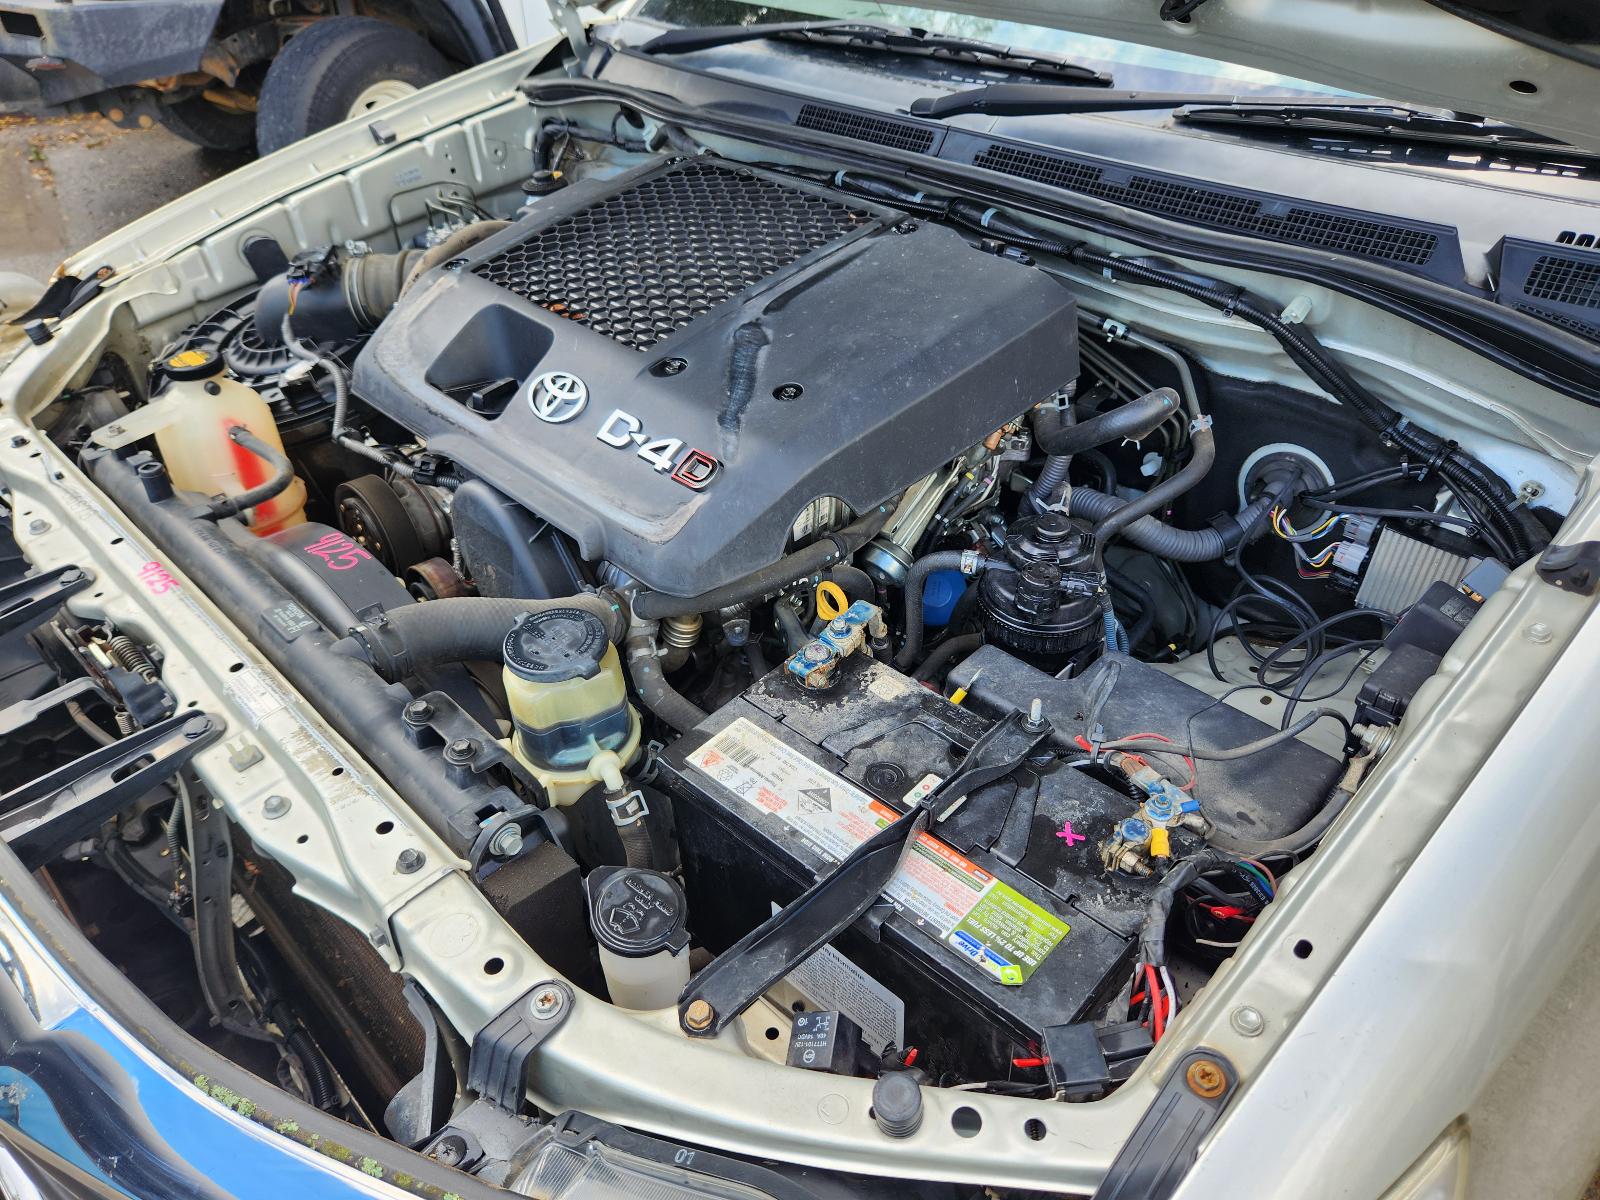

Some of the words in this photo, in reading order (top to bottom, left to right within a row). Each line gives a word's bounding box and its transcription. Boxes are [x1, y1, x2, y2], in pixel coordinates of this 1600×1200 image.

[303, 532, 371, 570] 9125
[964, 915, 982, 929] FUEL
[978, 924, 996, 939] LESS
[993, 934, 1007, 946] 2%
[955, 939, 979, 957] Drive
[1004, 942, 1015, 952] TO
[1012, 947, 1025, 959] UP
[1021, 954, 1037, 967] USE
